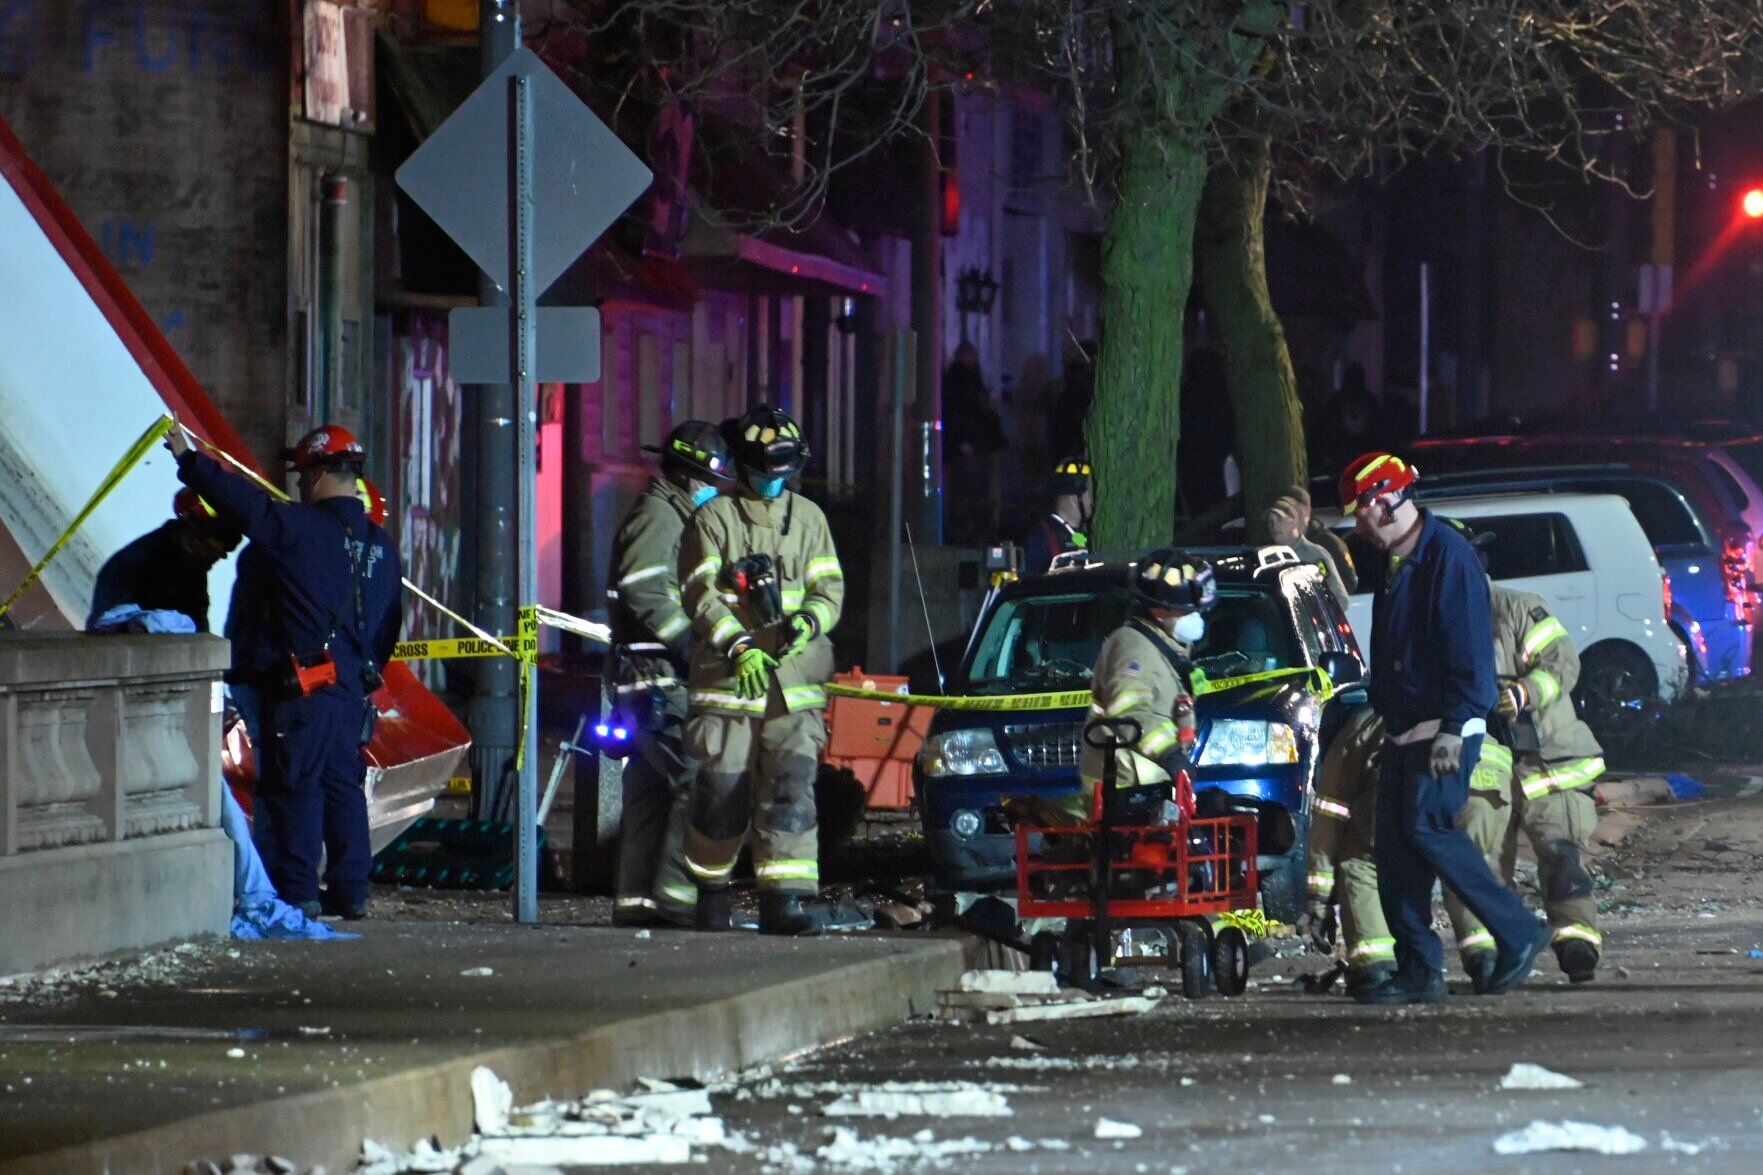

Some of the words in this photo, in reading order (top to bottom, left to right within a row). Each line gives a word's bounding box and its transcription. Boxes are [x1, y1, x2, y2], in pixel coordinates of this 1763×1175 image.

[392, 642, 428, 657] CROSS
[457, 639, 493, 654] POLICE
[523, 639, 536, 650] DO
